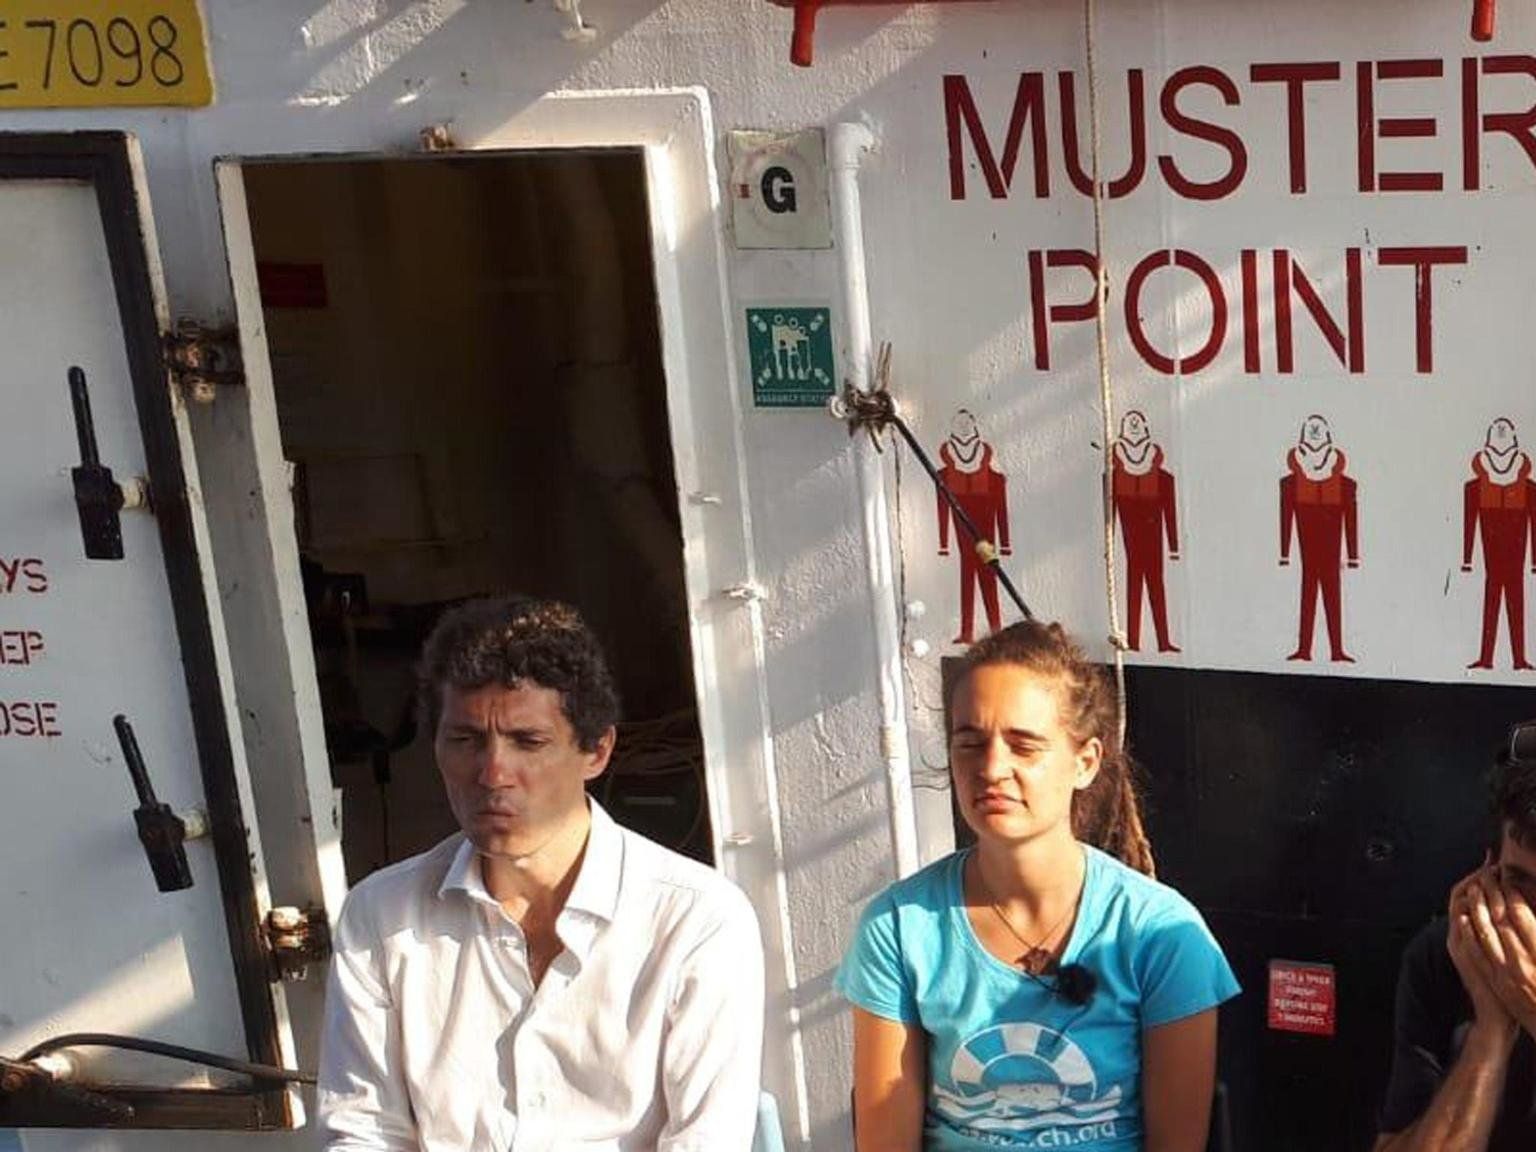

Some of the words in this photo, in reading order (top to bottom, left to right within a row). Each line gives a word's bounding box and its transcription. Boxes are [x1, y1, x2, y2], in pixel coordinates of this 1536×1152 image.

[761, 166, 797, 213] G
[1028, 246, 1468, 375] POINT
[0, 558, 47, 592] YS
